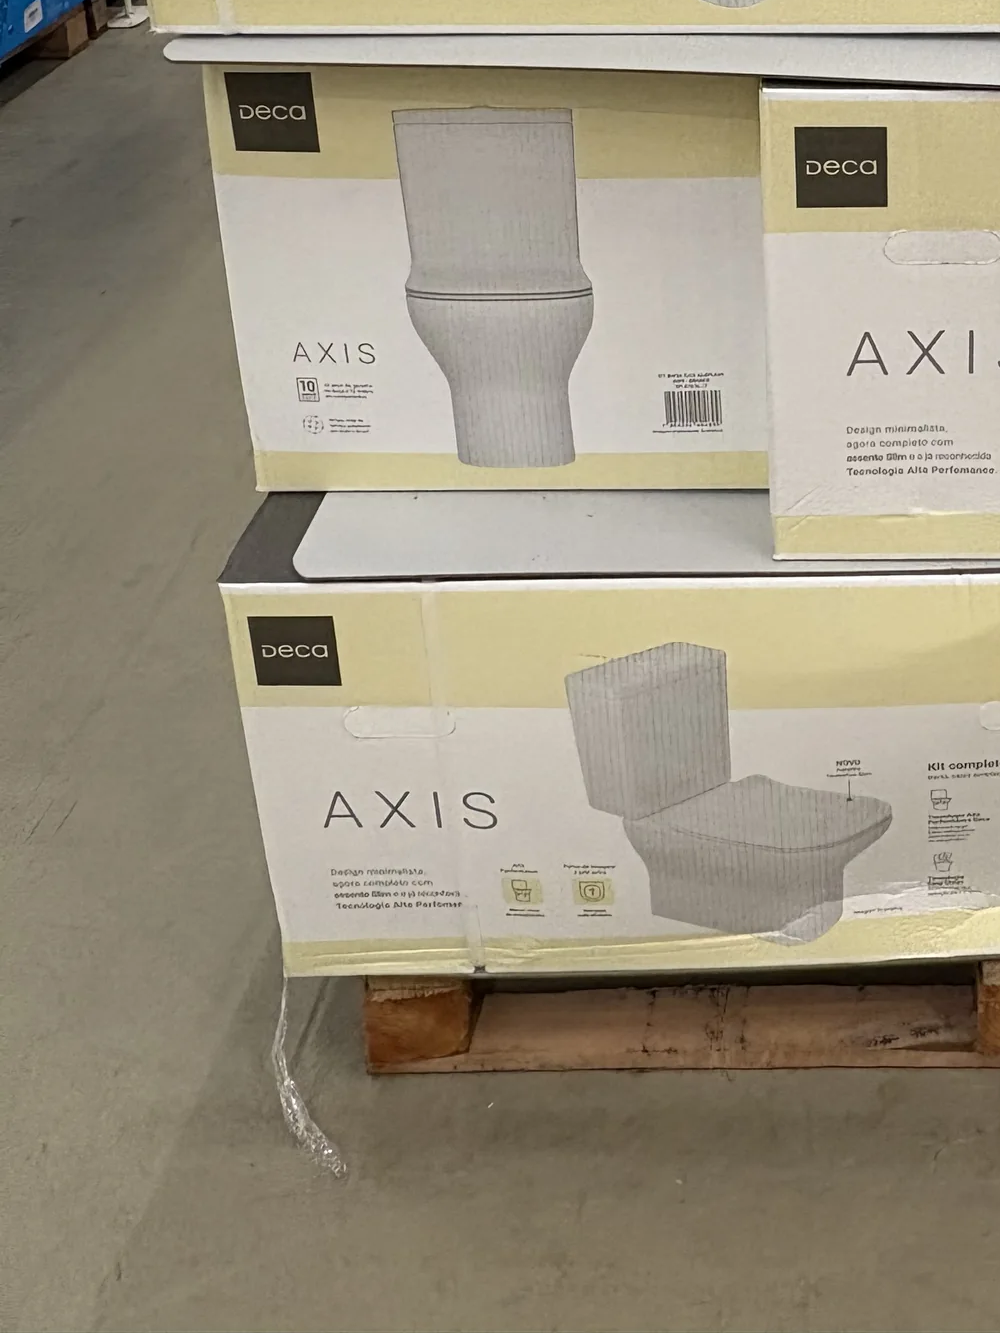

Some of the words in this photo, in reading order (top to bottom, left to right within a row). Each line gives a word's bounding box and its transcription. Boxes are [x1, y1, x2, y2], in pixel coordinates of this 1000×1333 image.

[239, 104, 306, 120] Deca
[806, 159, 877, 175] Deca
[293, 342, 376, 364] AXIS
[299, 380, 315, 392] 10
[846, 426, 881, 435] Design
[879, 438, 928, 449] completo
[931, 438, 954, 447] com
[846, 466, 904, 477] Tecnologia
[262, 643, 328, 659] Deca
[927, 762, 945, 772] Kit
[323, 790, 498, 830] AXIS
